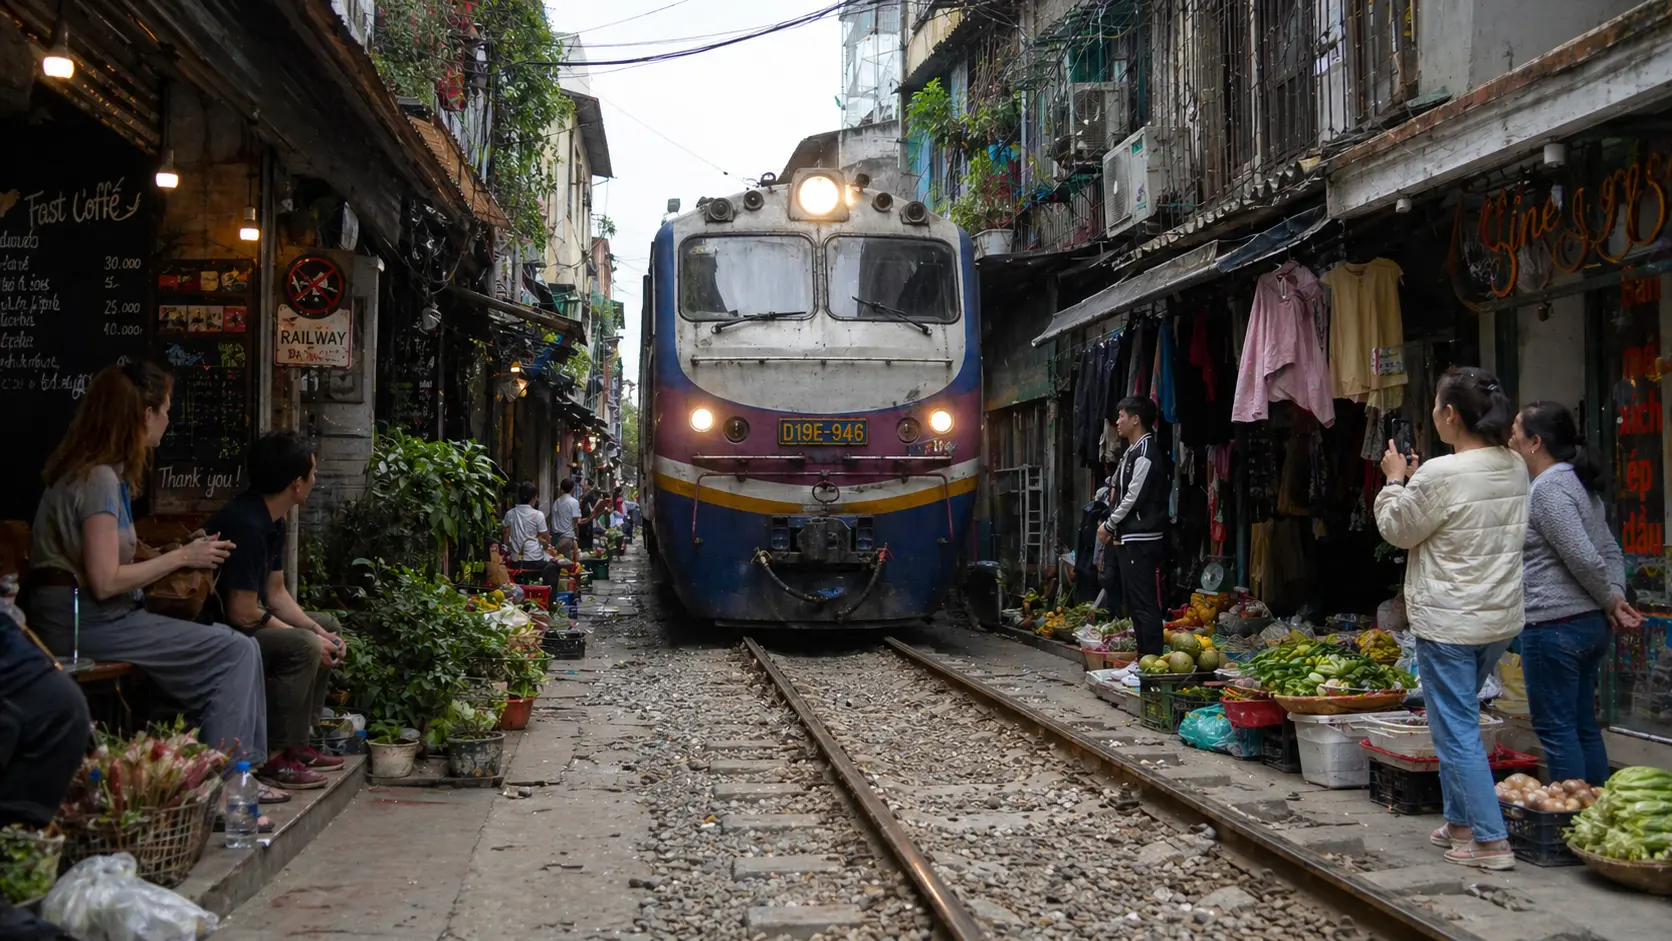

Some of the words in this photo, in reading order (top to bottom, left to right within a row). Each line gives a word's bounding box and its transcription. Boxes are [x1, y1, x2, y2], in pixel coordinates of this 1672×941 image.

[24, 190, 67, 228] Fast
[104, 255, 141, 270] 30.000
[104, 300, 140, 314] 25.000
[281, 330, 347, 345] RAILWAY
[783, 423, 864, 441] D19E-946
[159, 465, 201, 488] Thank
[1626, 450, 1653, 501] ép
[1622, 504, 1663, 555] dầu
